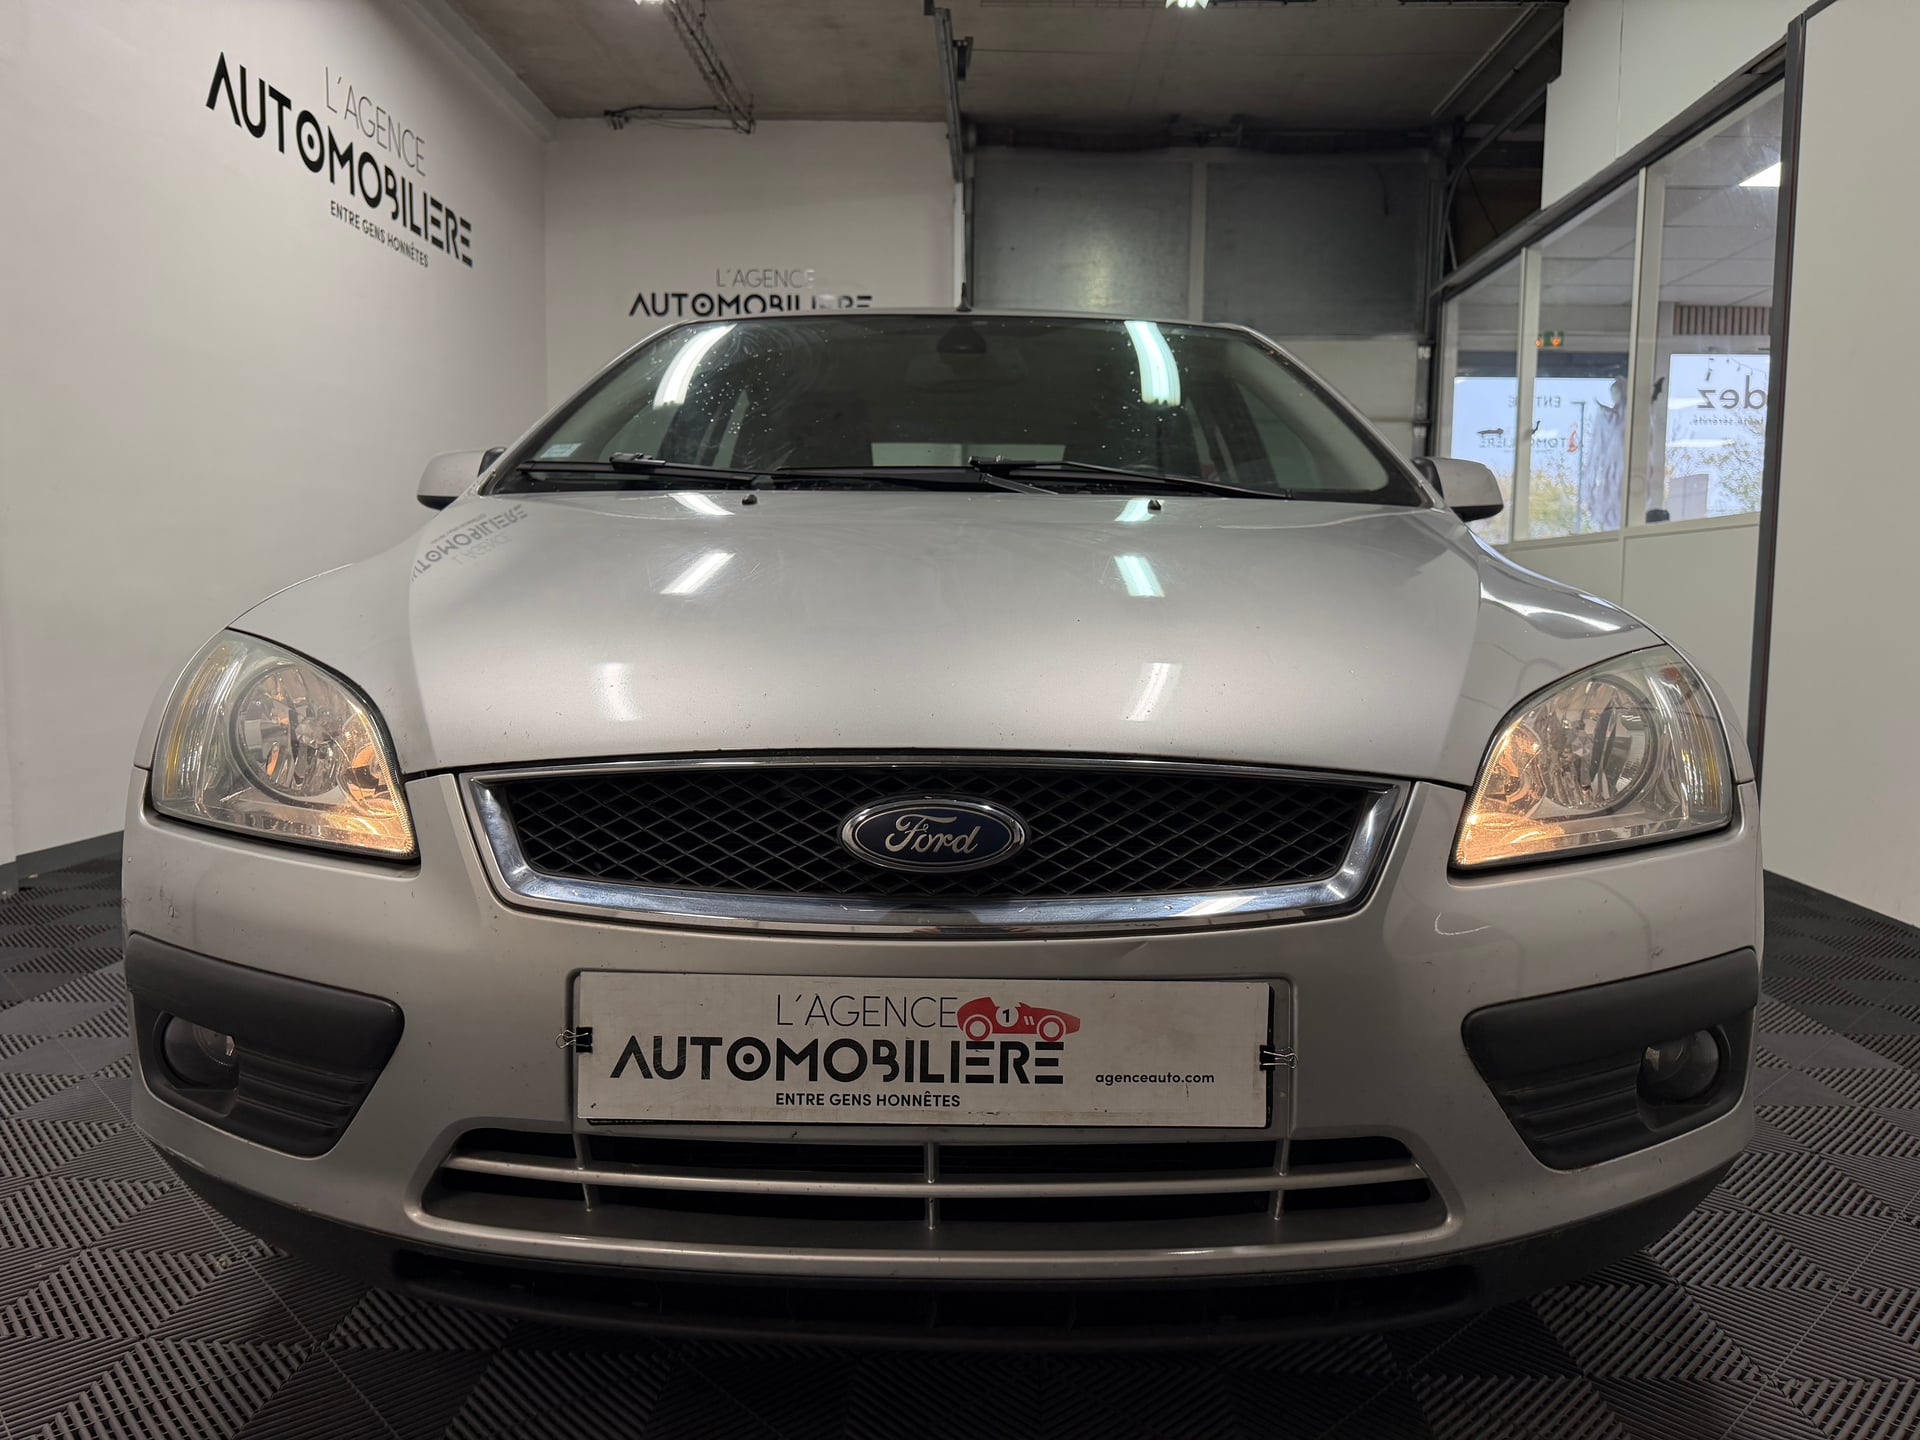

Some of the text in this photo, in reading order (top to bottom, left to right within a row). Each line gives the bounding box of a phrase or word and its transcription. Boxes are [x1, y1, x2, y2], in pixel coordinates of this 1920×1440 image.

[325, 66, 426, 177] L'AGENCE
[206, 51, 473, 268] AUTOMOBILIERE
[330, 200, 429, 268] ENTRE GENS HONNÊTES
[885, 813, 981, 854] Ford
[777, 994, 958, 1029] L'AGENCE
[1002, 1009, 1011, 1024] 1
[610, 1035, 1064, 1085] AUTOMOBILIERE
[1095, 1072, 1215, 1087] agenceauto.com
[776, 1090, 961, 1108] ENTRE GENS HONNÊTES
